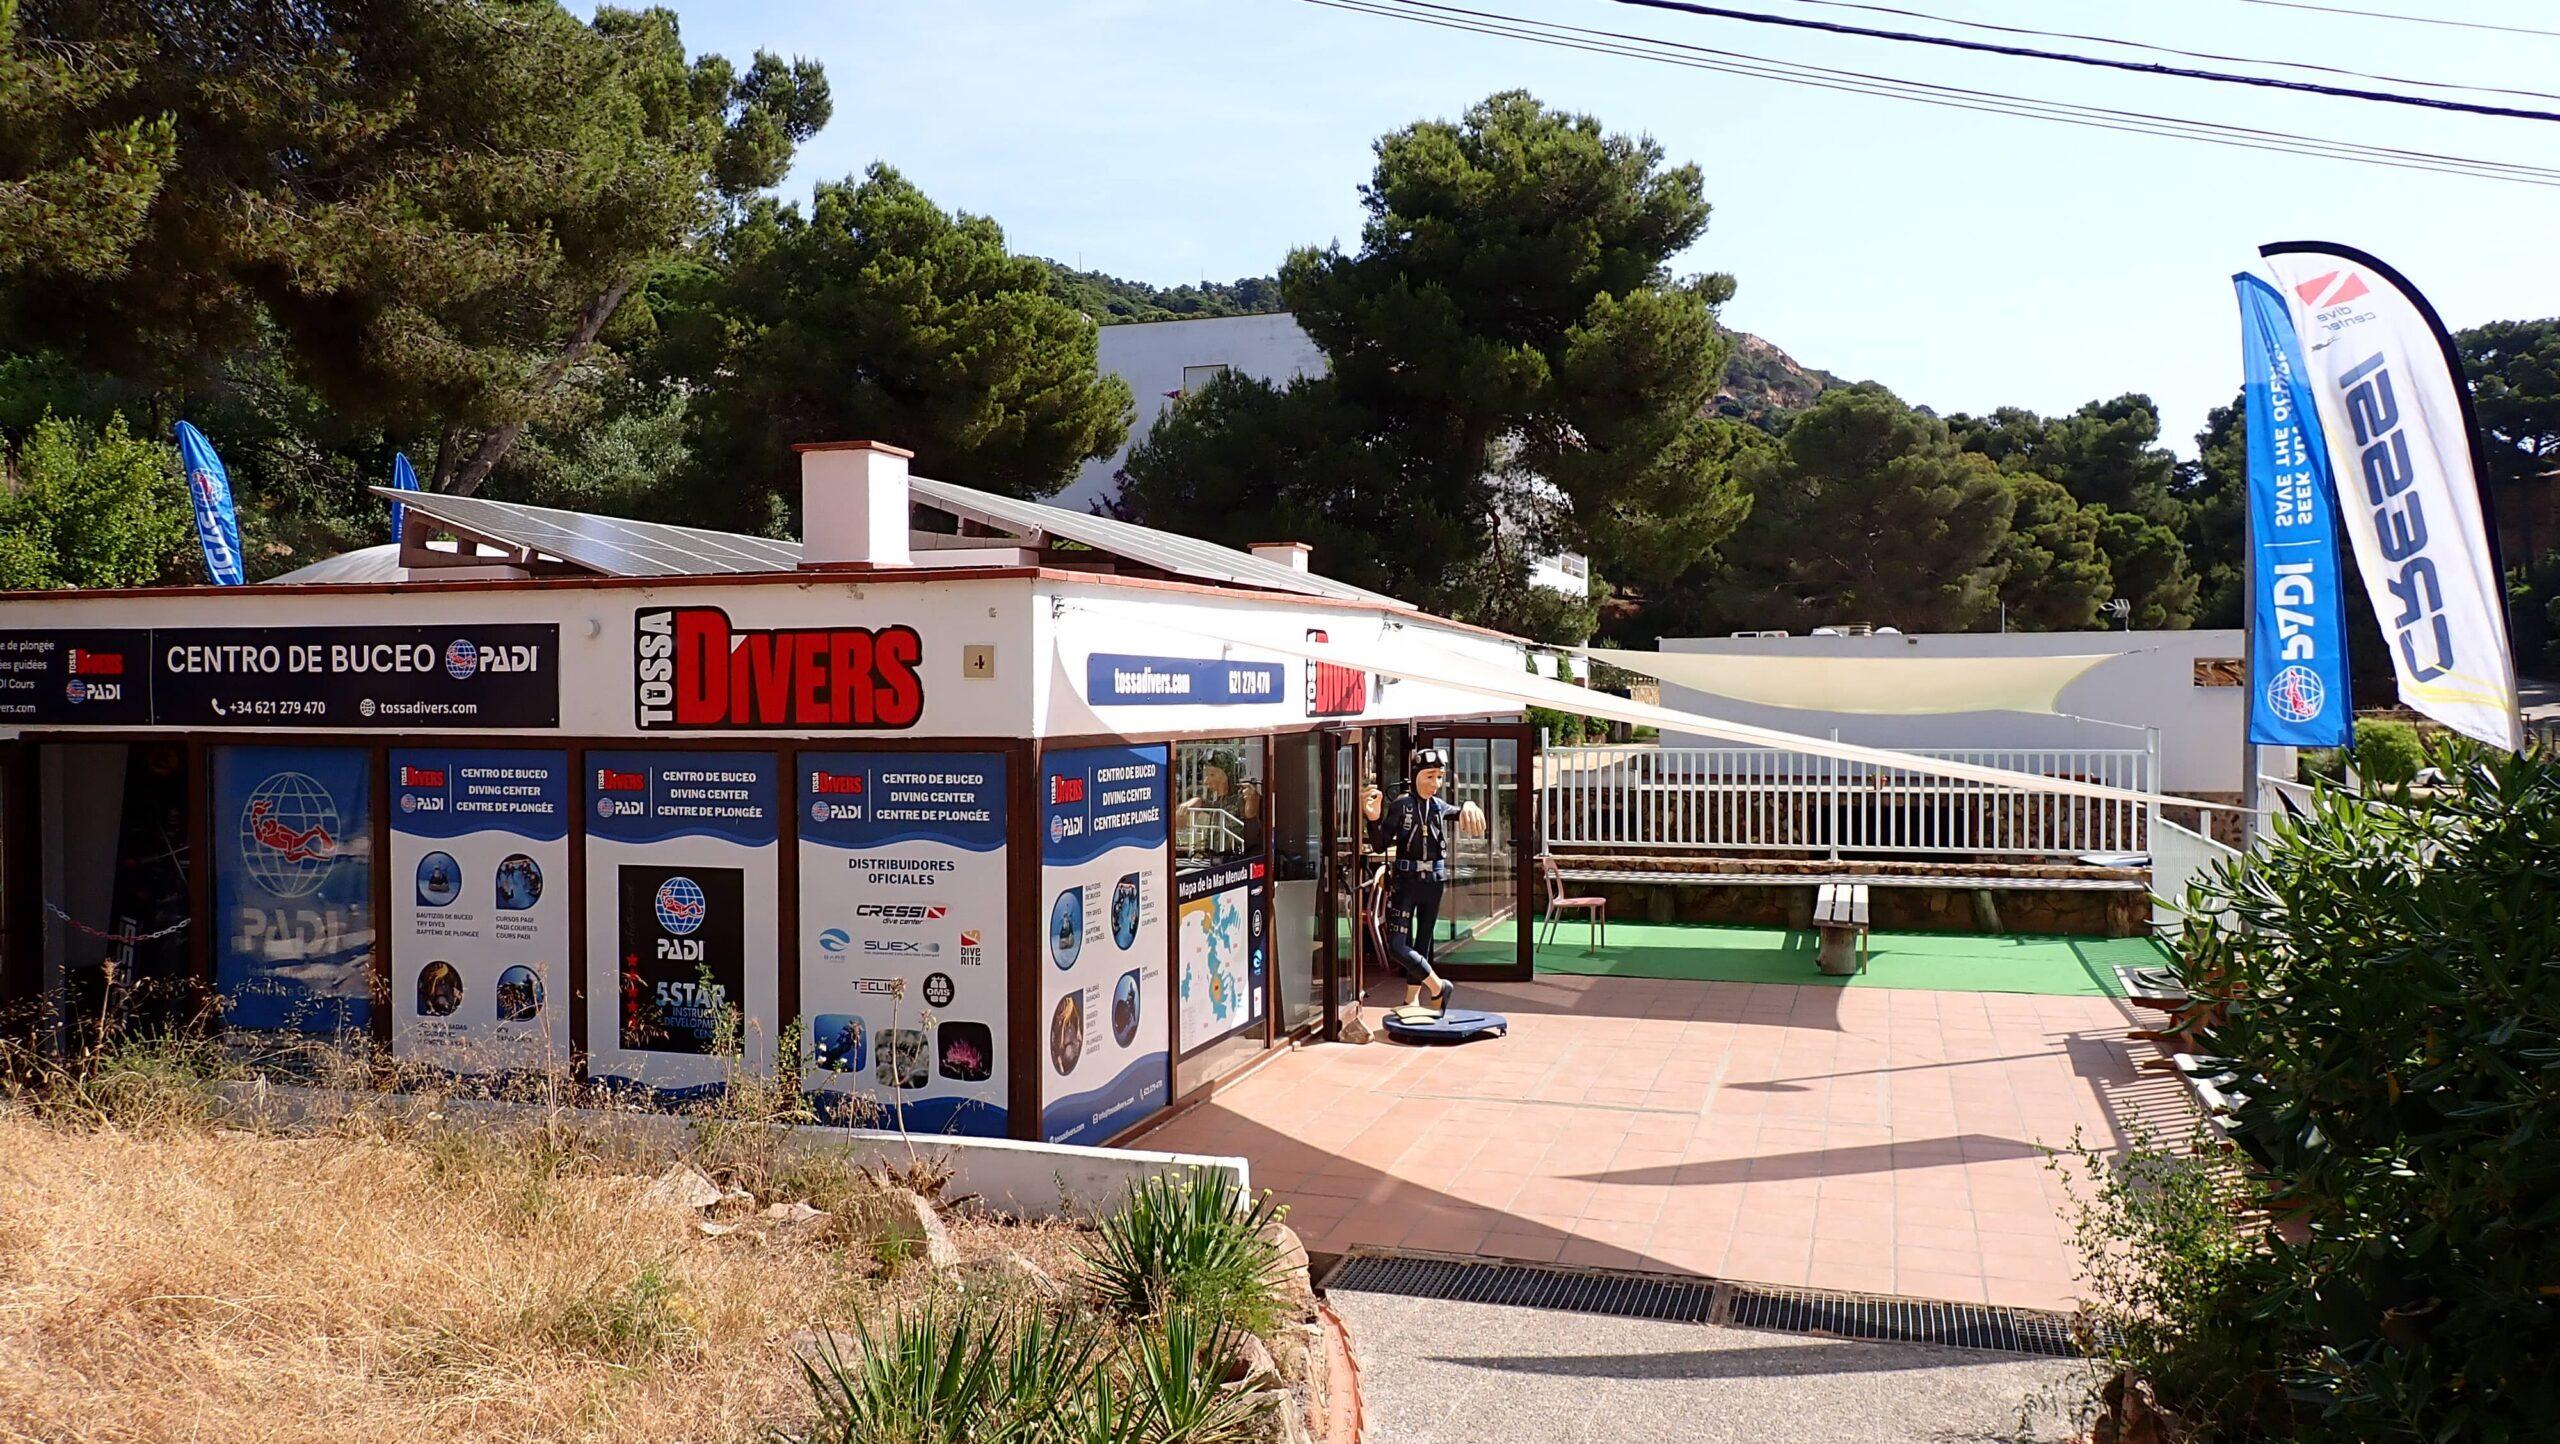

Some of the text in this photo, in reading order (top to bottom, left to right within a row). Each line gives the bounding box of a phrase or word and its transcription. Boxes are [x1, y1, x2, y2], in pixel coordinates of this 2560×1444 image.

[7, 640, 18, 650] de
[167, 644, 436, 673] CENTRO DE BUCEO
[479, 645, 538, 672] PADI
[973, 654, 985, 670] 4
[639, 611, 673, 726] TOSSA
[9, 679, 35, 689] Cours
[1114, 667, 1190, 694] tossadivers.com
[1228, 670, 1270, 694] 621 279 470
[86, 684, 121, 700] PADI
[229, 701, 326, 714] +34 621 279 470
[380, 701, 477, 714] tossadivers.com
[461, 769, 548, 779] CENTRO DE BUCEO
[663, 771, 757, 782] CENTRO DE BUCEO
[882, 773, 983, 785] CENTRO DE BUCEO
[1097, 764, 1156, 783] CENTRO DE BUCEO
[468, 785, 541, 796] DIVING CENTER
[670, 789, 749, 800] DIVING CENTER
[890, 791, 975, 803] DIVING CENTER
[1102, 787, 1151, 806] DIVING CENTER
[417, 797, 444, 810] PADI
[456, 801, 554, 813] CENTRE DE PLONGÉE
[615, 801, 644, 814] PADI
[657, 805, 763, 818] CENTRE DE PLONGÉE
[830, 805, 862, 819] PADI
[876, 809, 990, 822] CENTRE DE PLONGÉE
[1093, 806, 1160, 831] CENTRE DE PLONGÉE
[1063, 816, 1083, 837] PADI
[849, 858, 955, 871] DISTRIBUIDORES
[868, 873, 935, 885] OFICIALES
[1179, 881, 1197, 899] Mapa
[1197, 877, 1206, 892] de
[1206, 876, 1212, 890] la
[1213, 873, 1225, 888] Mar
[1225, 866, 1248, 884] Menuda
[856, 904, 927, 918] CRESSI
[243, 908, 339, 953] PADI
[657, 938, 704, 961] PADI
[864, 941, 919, 952] SUEX
[852, 980, 895, 991] TECLIN
[926, 988, 950, 996] OMS
